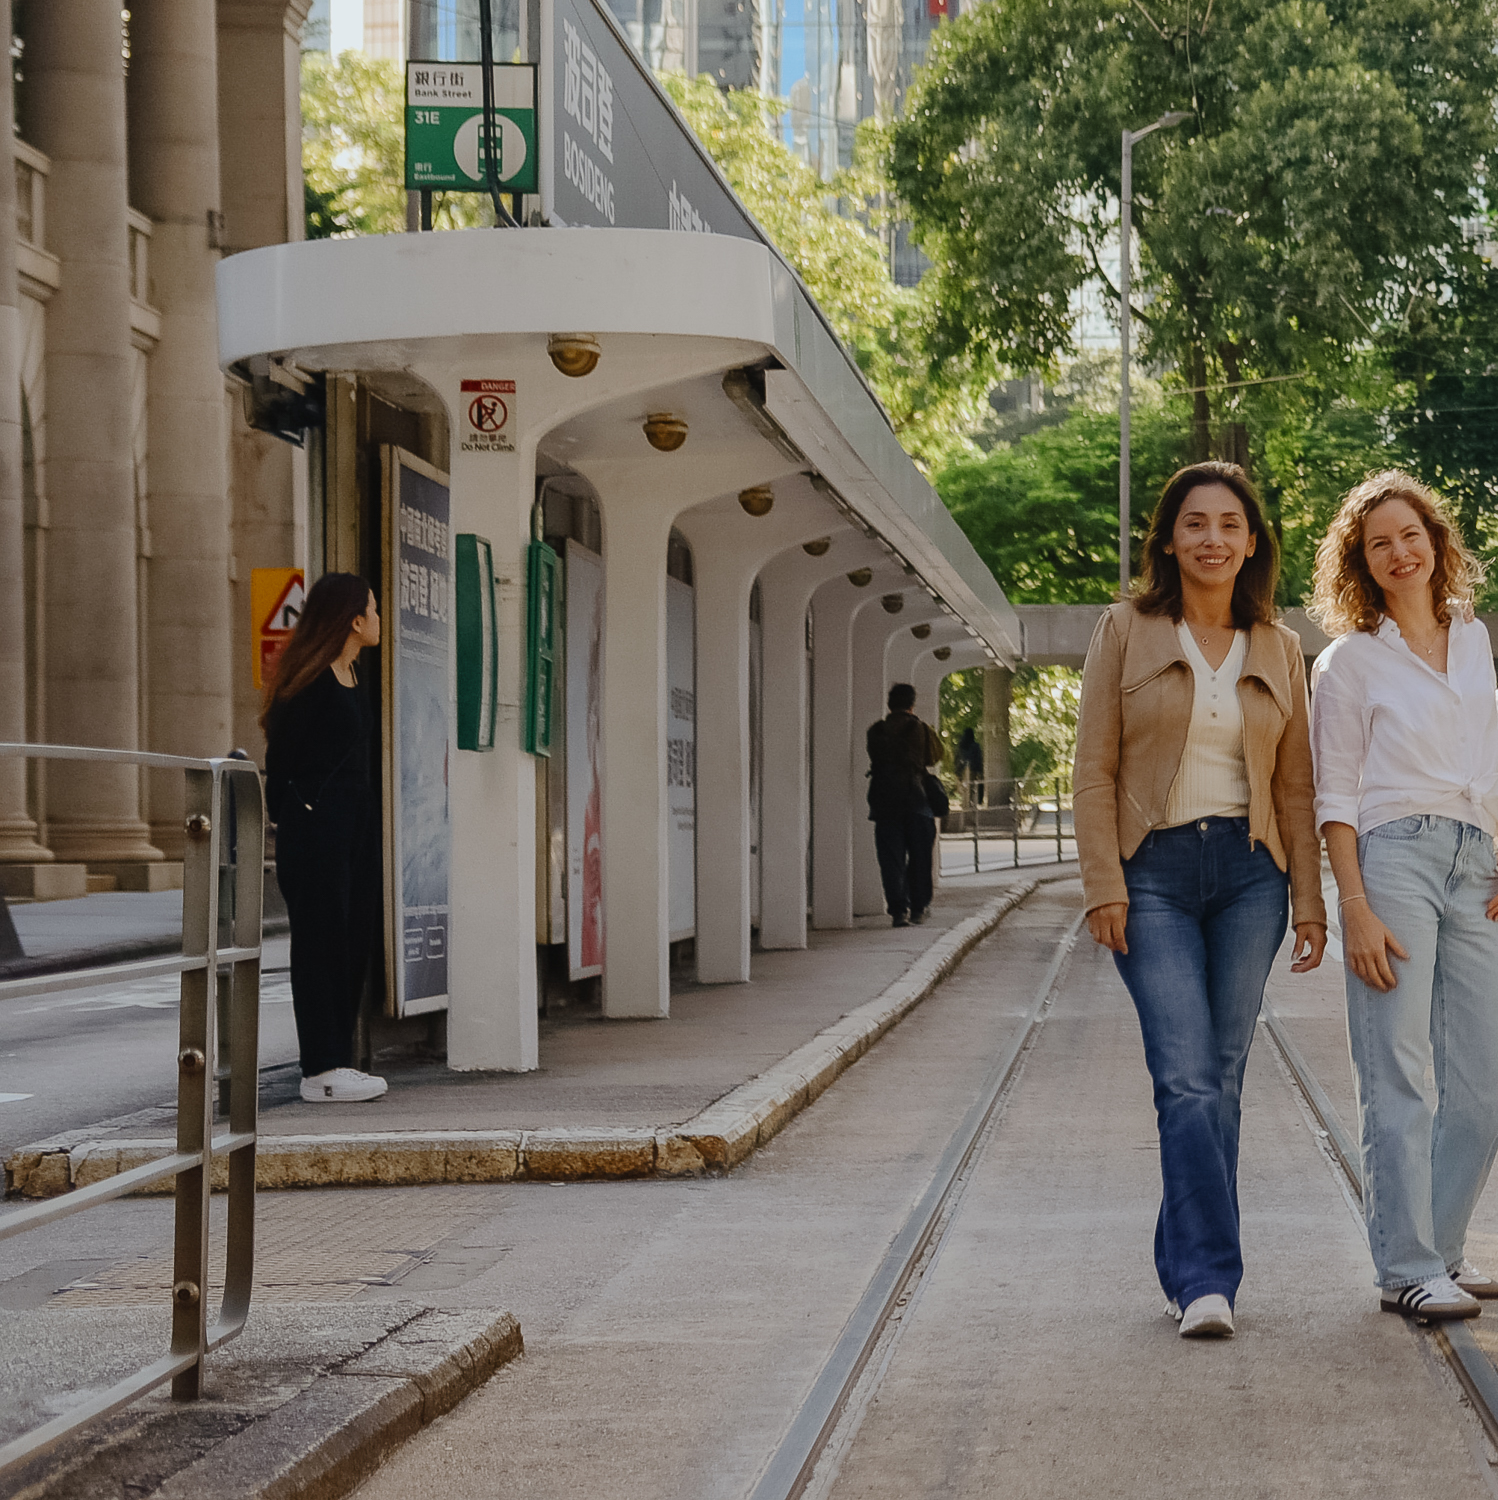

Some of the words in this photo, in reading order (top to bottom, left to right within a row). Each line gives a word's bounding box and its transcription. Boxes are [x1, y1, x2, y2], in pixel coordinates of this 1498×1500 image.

[415, 71, 464, 87] 銀行街
[415, 89, 438, 97] Bank
[442, 90, 472, 99] Street
[563, 17, 613, 165] 波司登
[415, 111, 440, 125] 31E
[414, 173, 455, 181] Eastbound
[564, 130, 615, 226] BOSIDENG
[481, 382, 516, 391] DANGER
[461, 442, 473, 451] Do
[474, 442, 489, 451] Not
